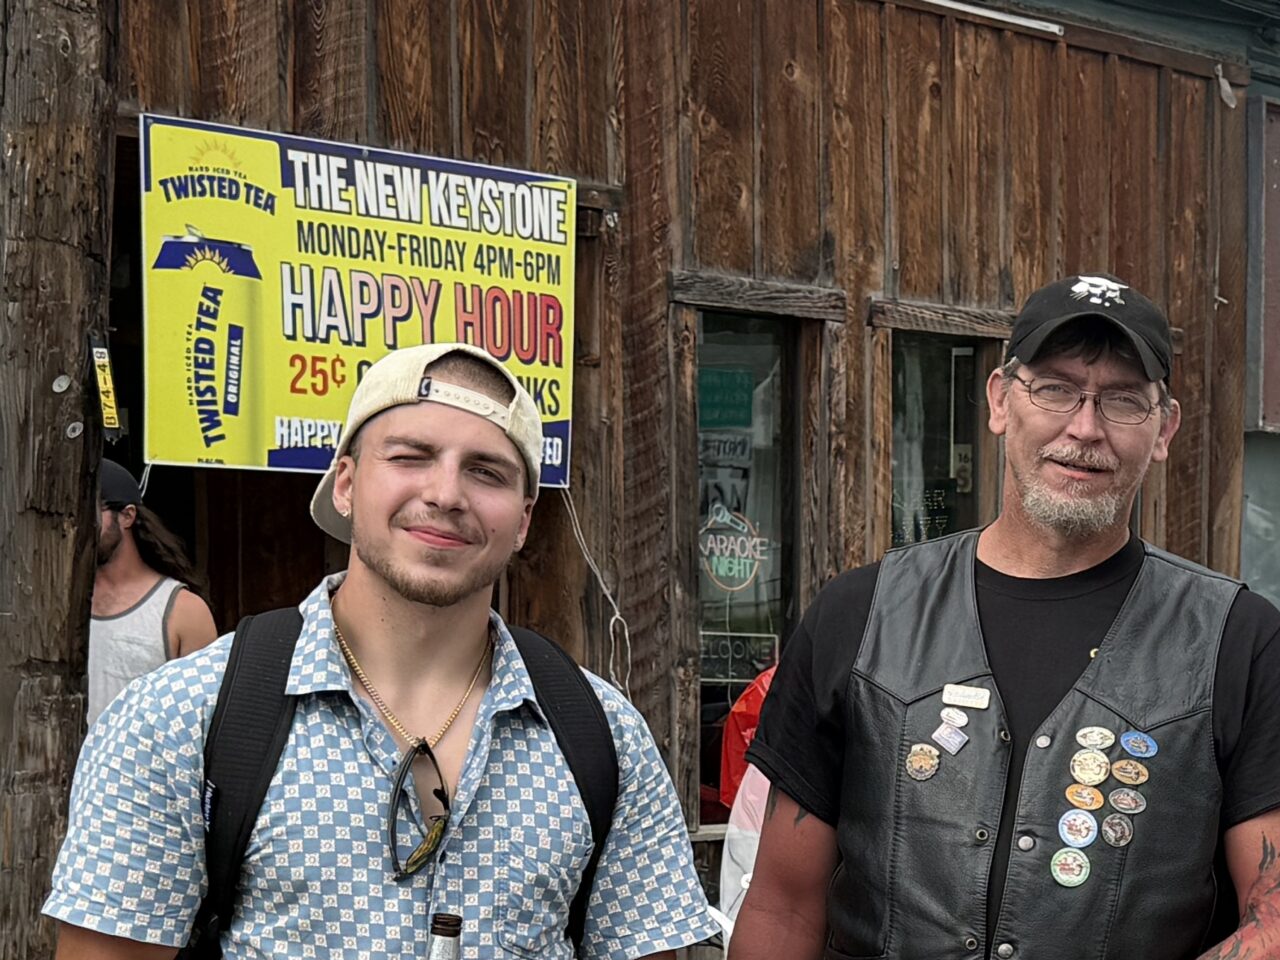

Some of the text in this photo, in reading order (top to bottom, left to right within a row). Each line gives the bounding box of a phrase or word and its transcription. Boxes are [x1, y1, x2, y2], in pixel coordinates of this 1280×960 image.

[158, 174, 278, 216] TWISTED TEA
[212, 167, 231, 175] ICED
[233, 170, 248, 180] TEA
[287, 148, 568, 245] THE NEW KEYSTONE
[296, 219, 562, 286] MONDAY-FRIDAY 4PM-6PM
[195, 285, 224, 332] TEA
[280, 261, 564, 368] HAPPY HOUR
[194, 336, 227, 449] TWISTED
[226, 338, 242, 403] ORIGINAL
[289, 353, 347, 397] 25¢
[274, 415, 343, 449] HAPPY
[712, 556, 754, 579] NIGHT
[700, 640, 771, 660] ELCOME
